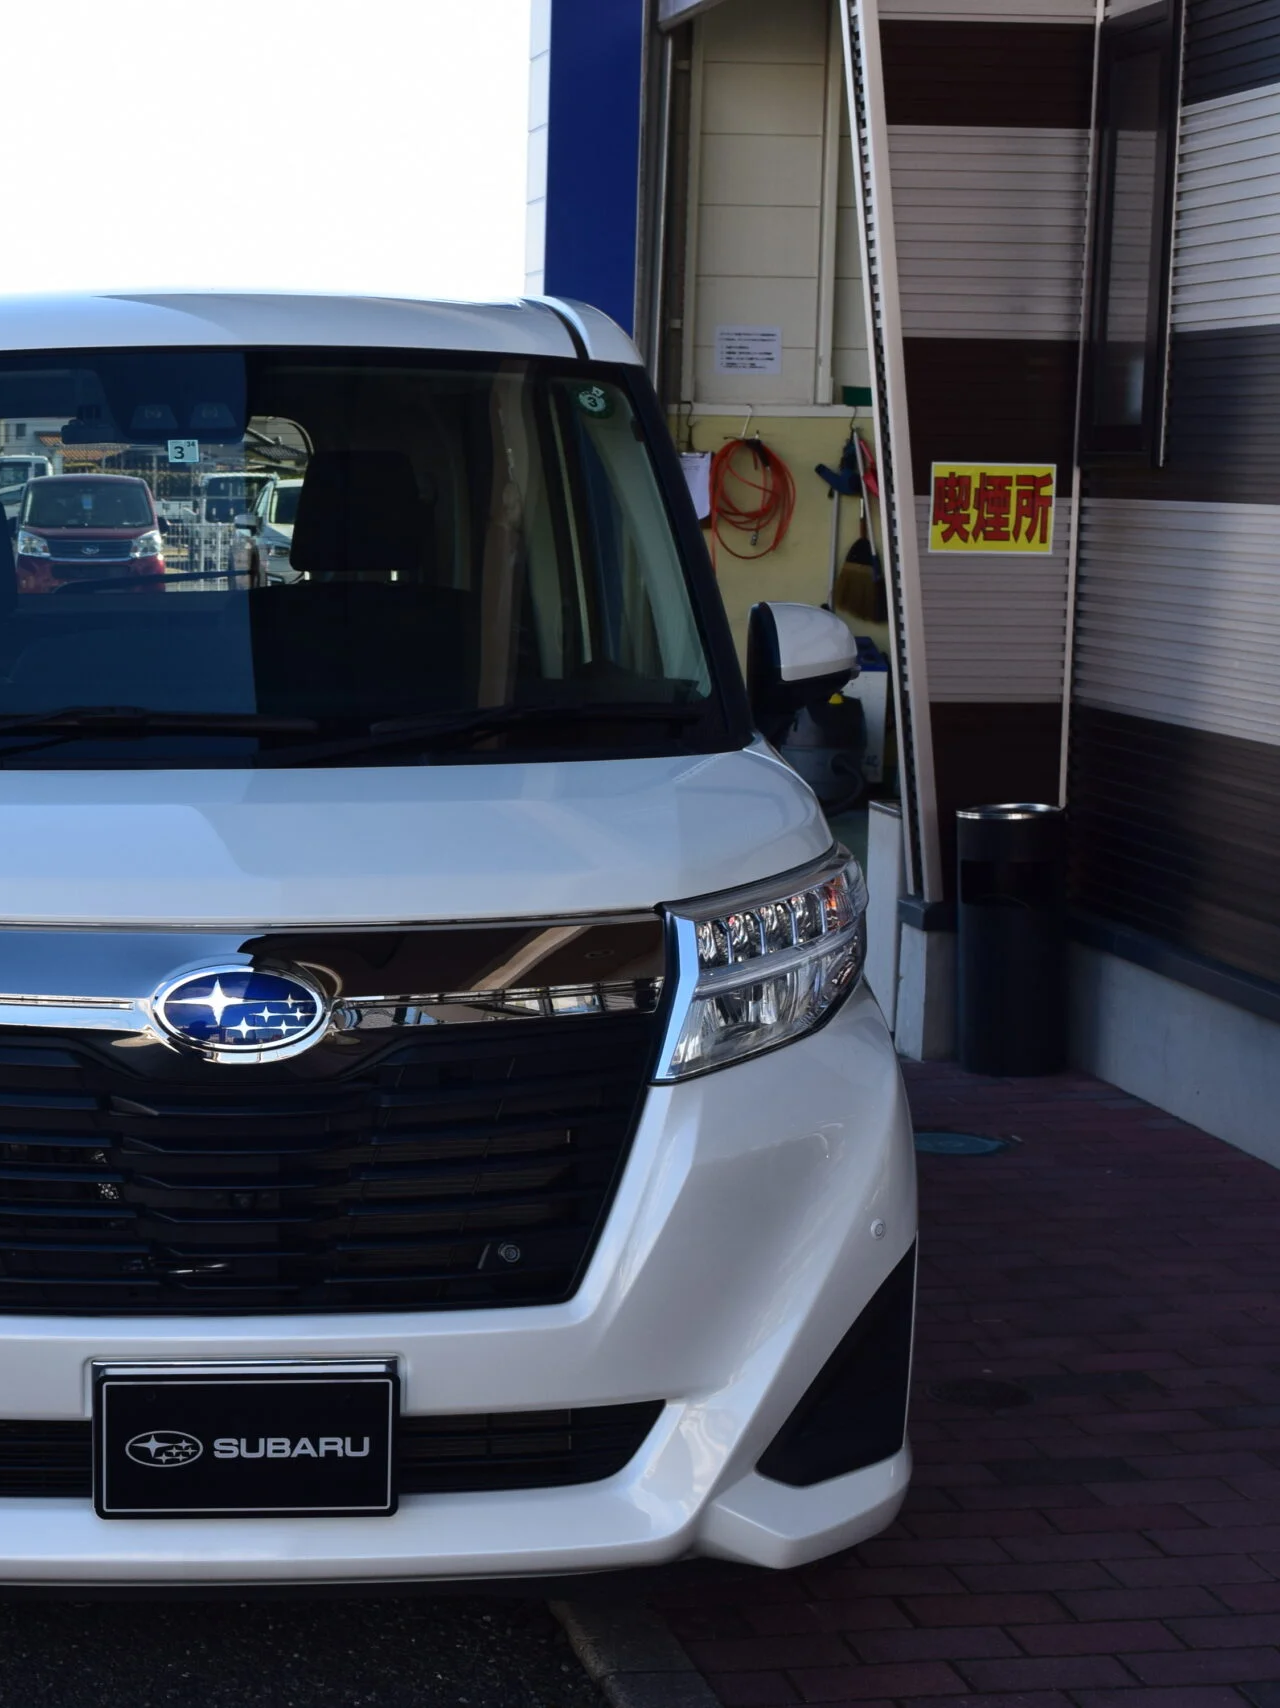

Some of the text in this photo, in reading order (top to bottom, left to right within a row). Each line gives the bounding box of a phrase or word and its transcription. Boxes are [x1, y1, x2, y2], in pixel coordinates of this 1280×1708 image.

[174, 446, 185, 460] 3
[932, 472, 1053, 544] 喫煙所
[213, 1437, 370, 1458] SUBARU
